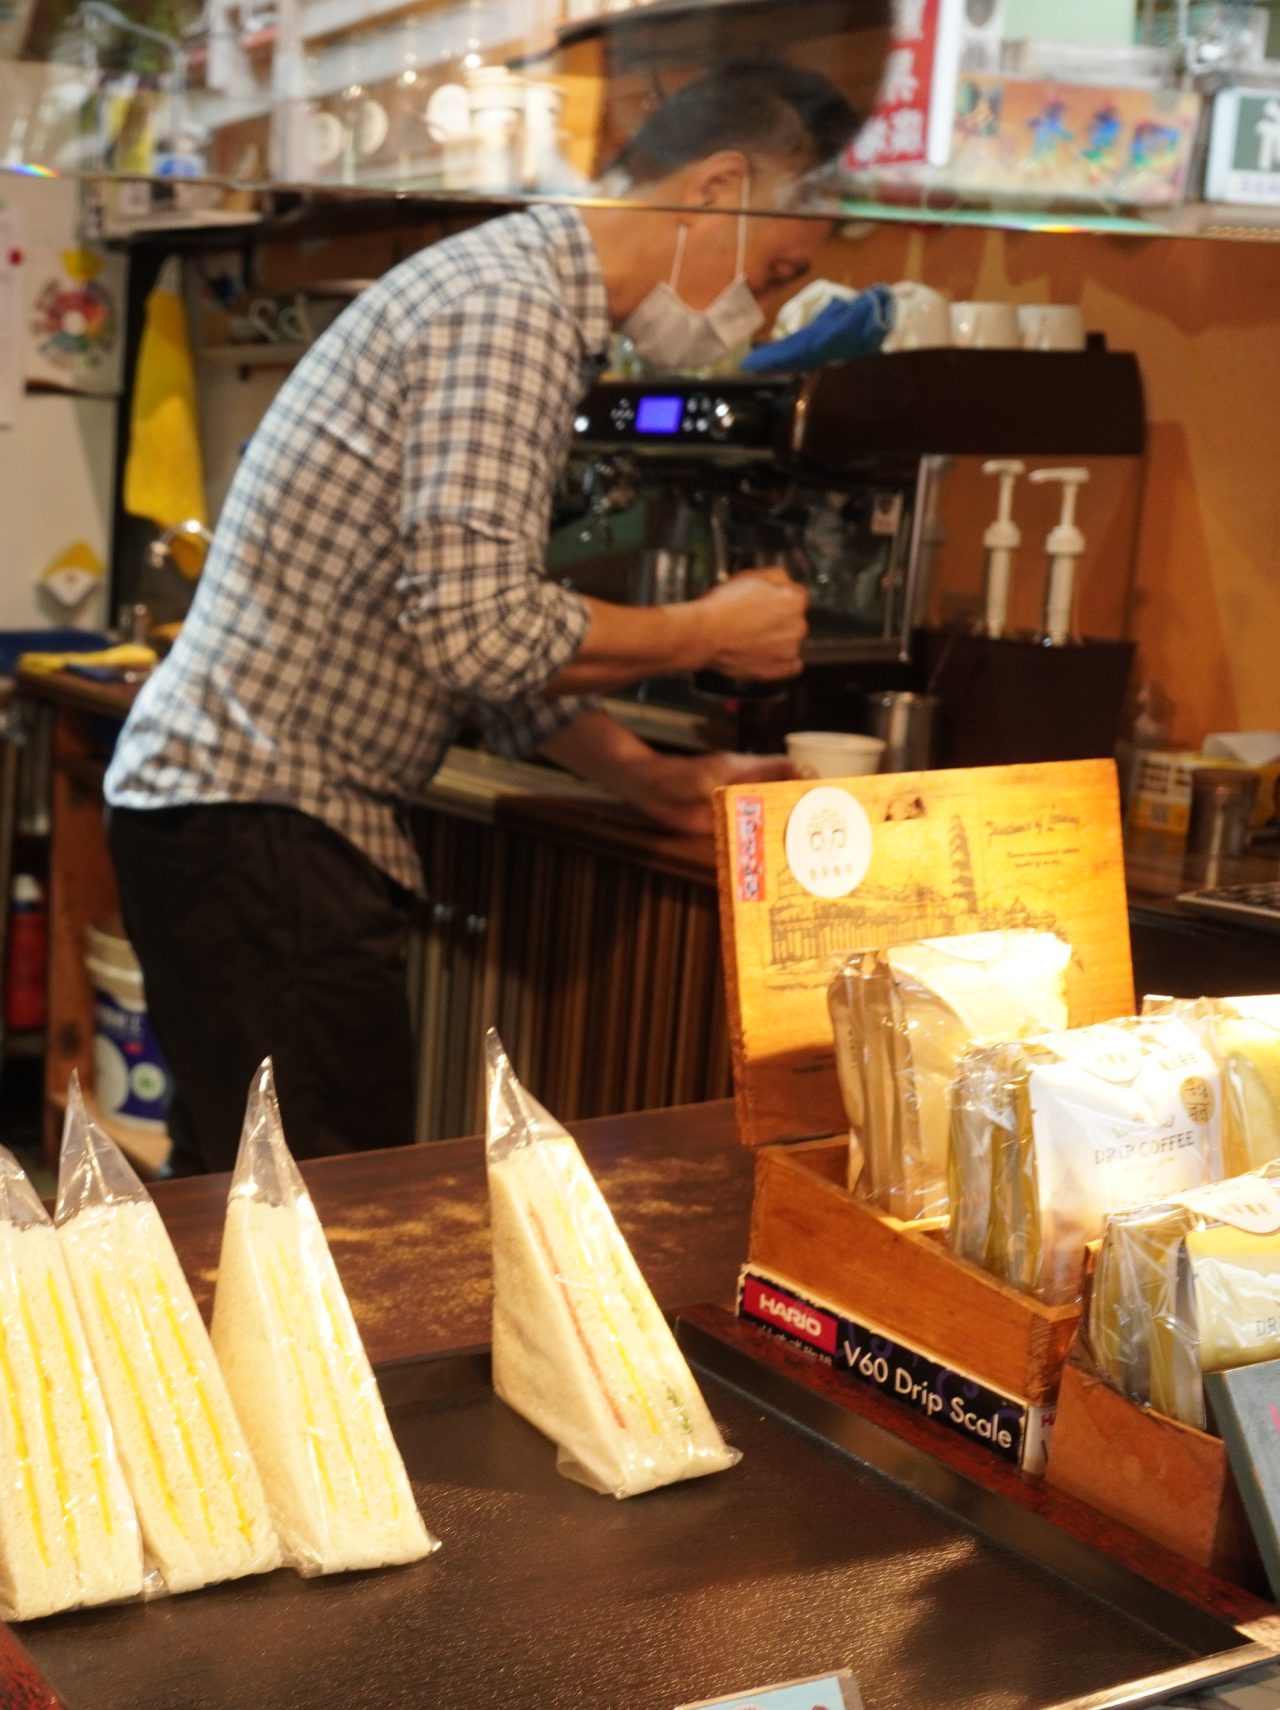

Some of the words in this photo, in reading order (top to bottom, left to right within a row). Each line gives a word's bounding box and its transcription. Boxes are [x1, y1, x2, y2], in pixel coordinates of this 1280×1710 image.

[1140, 1130, 1195, 1157] COFFEE
[758, 1292, 823, 1338] HARIO
[843, 1340, 889, 1384] V60
[894, 1366, 944, 1416] Drip
[949, 1396, 1014, 1449] Scale
